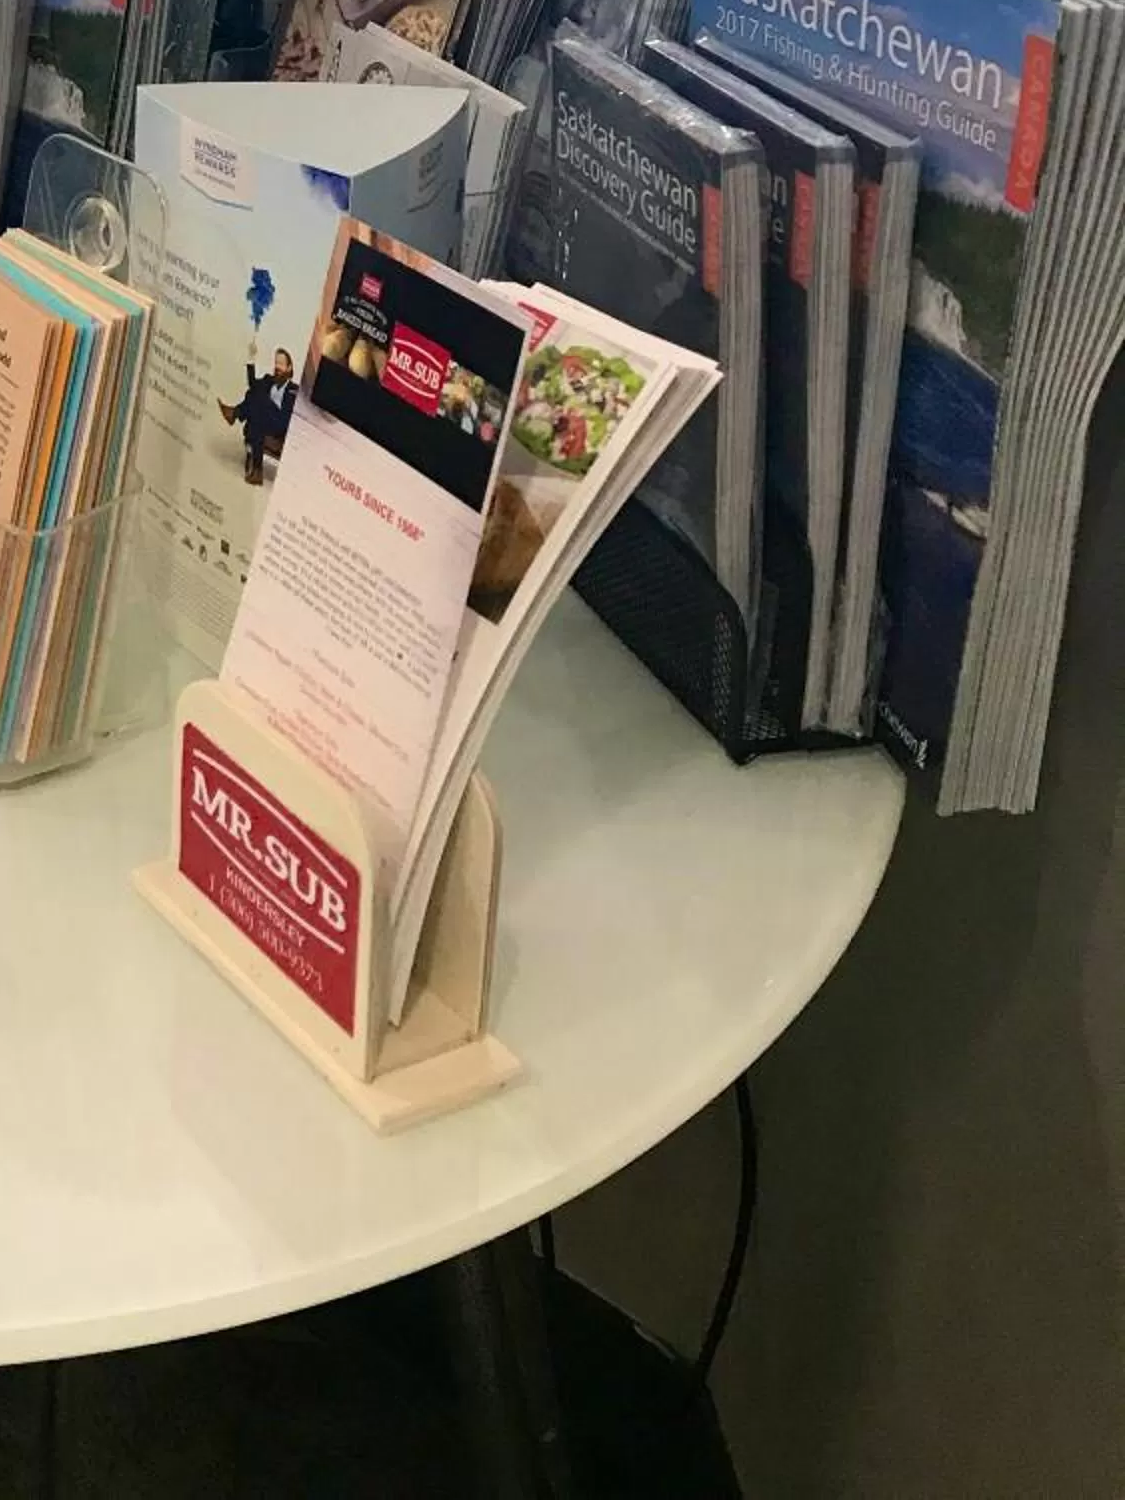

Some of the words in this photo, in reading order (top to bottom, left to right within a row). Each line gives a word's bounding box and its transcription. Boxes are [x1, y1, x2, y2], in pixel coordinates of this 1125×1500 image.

[715, 5, 760, 41] 2017
[763, 24, 824, 81] Fishing
[827, 54, 844, 85] &
[847, 61, 929, 127] Hunting
[936, 101, 997, 152] Guide
[556, 127, 638, 216] Discovery
[640, 189, 697, 254] Guide
[557, 90, 698, 220] Saskatchewan
[390, 346, 441, 390] MR.SUB
[362, 491, 393, 524] SINCE
[191, 765, 347, 933] MR.SUB
[226, 865, 306, 948] KINDERSLEY
